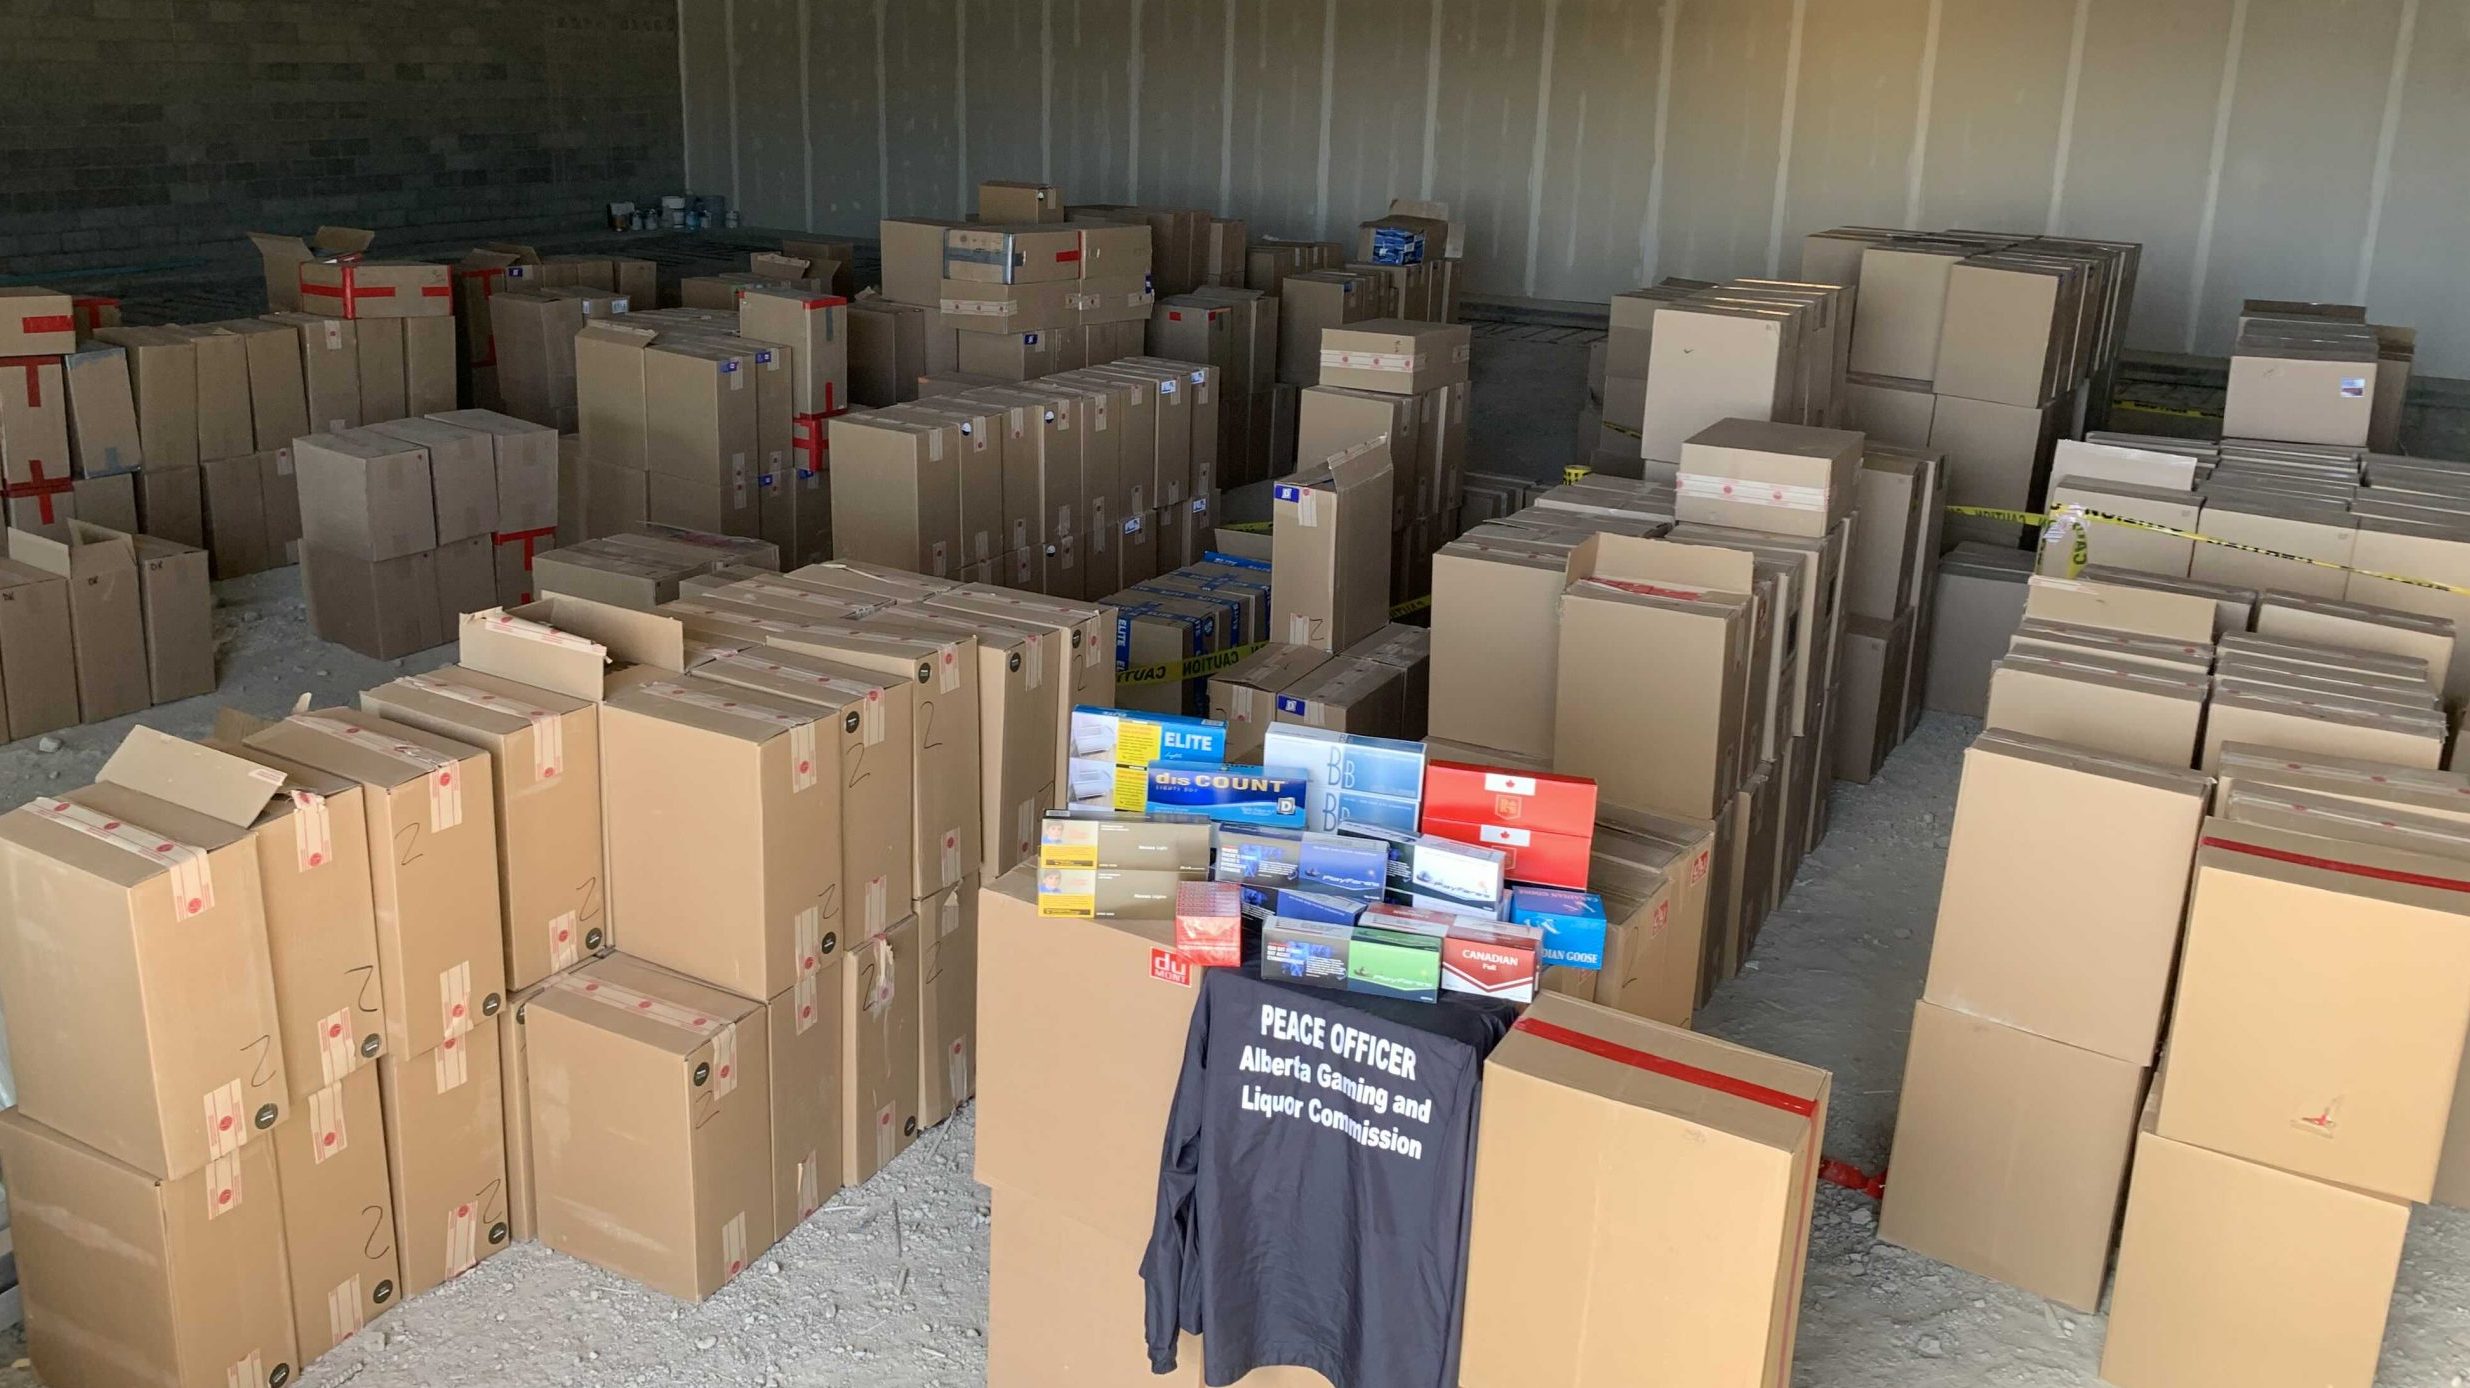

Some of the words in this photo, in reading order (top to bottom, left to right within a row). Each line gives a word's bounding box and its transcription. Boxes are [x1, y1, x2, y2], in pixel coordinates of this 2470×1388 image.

[1118, 619, 1127, 647] ELITE
[920, 700, 943, 749] 2
[1164, 731, 1213, 752] ELITE
[846, 742, 871, 788] 2
[394, 822, 424, 866] 2
[576, 876, 599, 922] 2
[818, 883, 840, 919] 2
[927, 941, 943, 985] 2
[1154, 970, 1186, 983] MONT
[1462, 949, 1519, 967] CANADIAN
[1567, 951, 1599, 964] GOOSE
[344, 965, 378, 1013] 2
[861, 963, 878, 1012] 2
[240, 1034, 277, 1088] 2
[1261, 1004, 1326, 1050] PEACE
[1330, 1023, 1416, 1081] OFFICER
[1239, 1045, 1311, 1083] Alberta
[1317, 1063, 1389, 1114] Gaming
[1392, 1094, 1432, 1124] and
[695, 1088, 720, 1130] 2
[1241, 1085, 1304, 1118] Liquor
[1308, 1098, 1422, 1160] Commission
[475, 1178, 502, 1224] 2
[361, 1205, 390, 1260] 2
